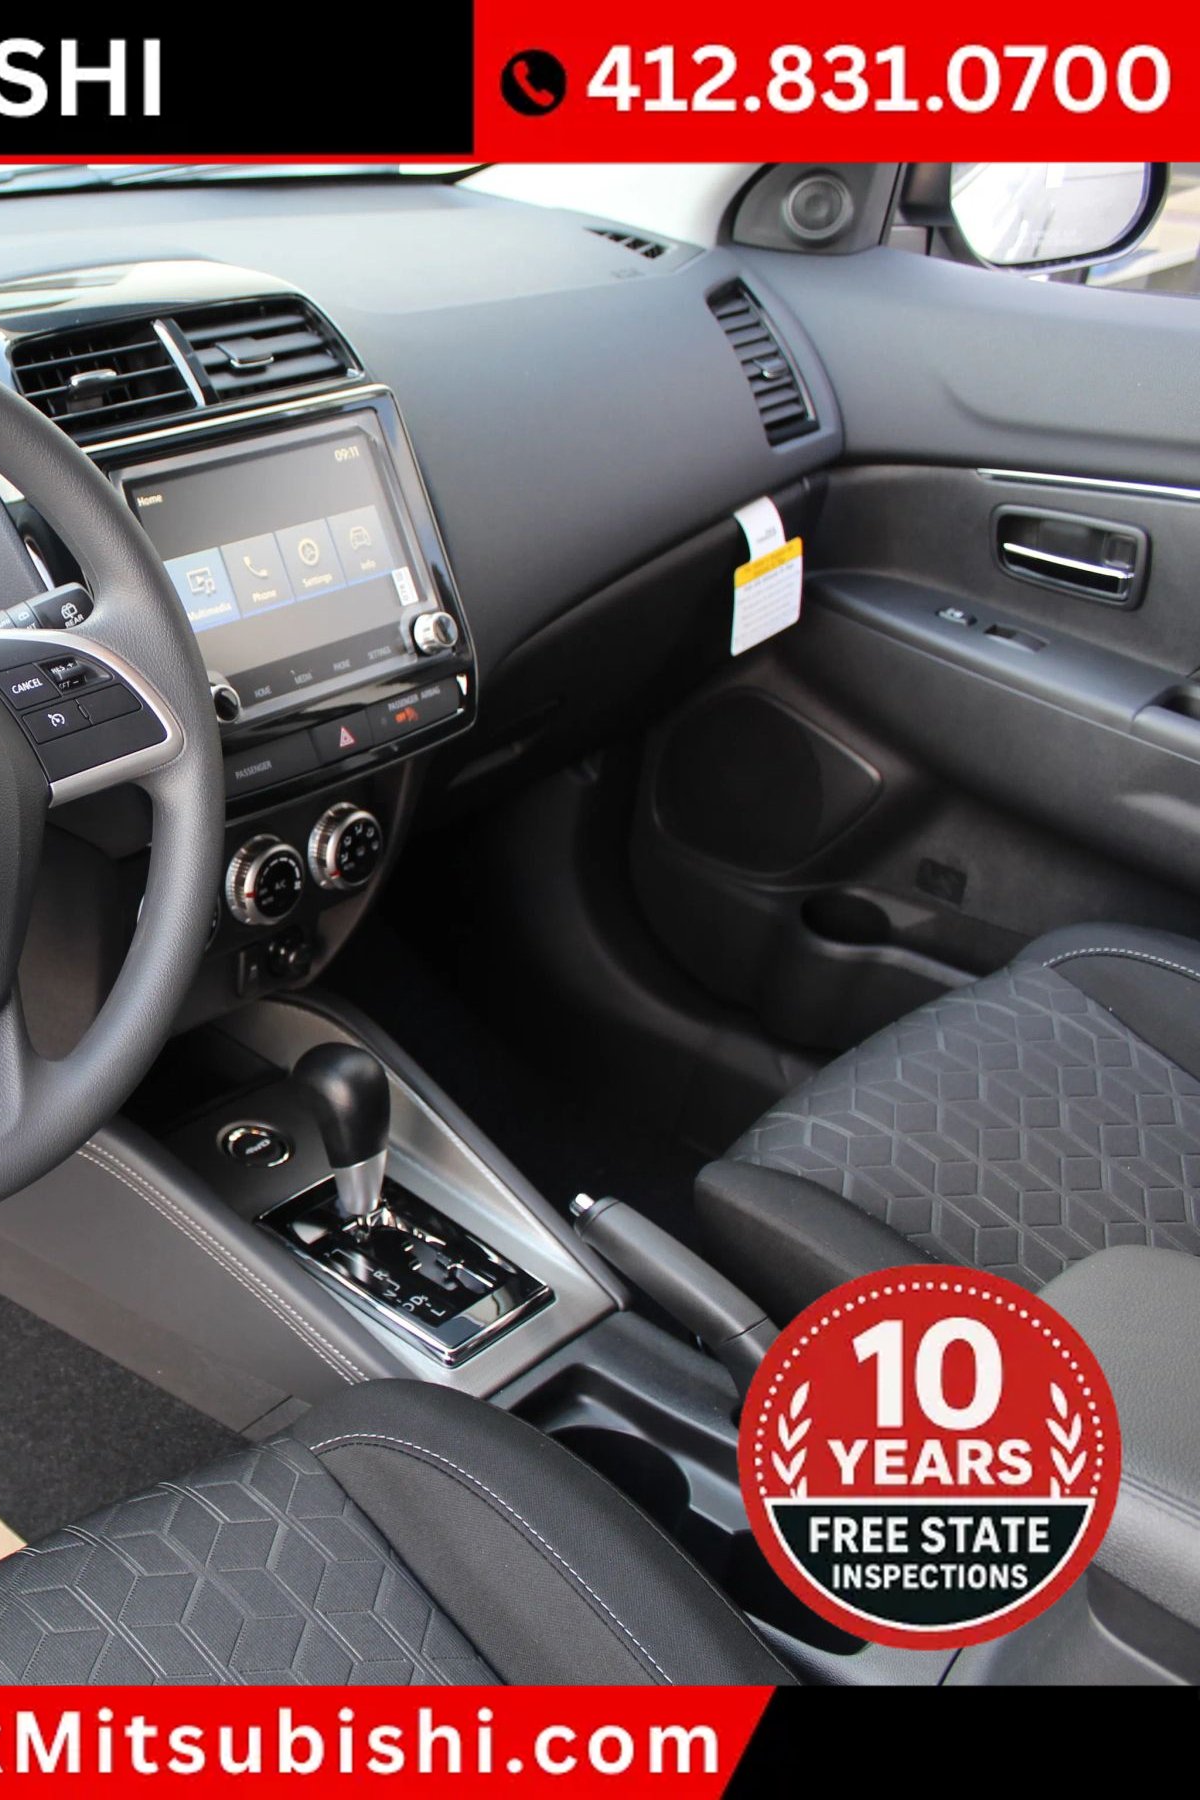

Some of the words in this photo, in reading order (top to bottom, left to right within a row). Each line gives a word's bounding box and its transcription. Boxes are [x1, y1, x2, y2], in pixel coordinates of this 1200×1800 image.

[334, 445, 360, 462] 09:11
[137, 491, 163, 508] Home
[252, 588, 277, 603] Phone
[64, 613, 84, 629] REAR
[11, 677, 44, 695] CANCEL
[253, 684, 273, 699] HOME
[387, 693, 420, 712] PASSENGER
[234, 759, 273, 780] PASSENGER
